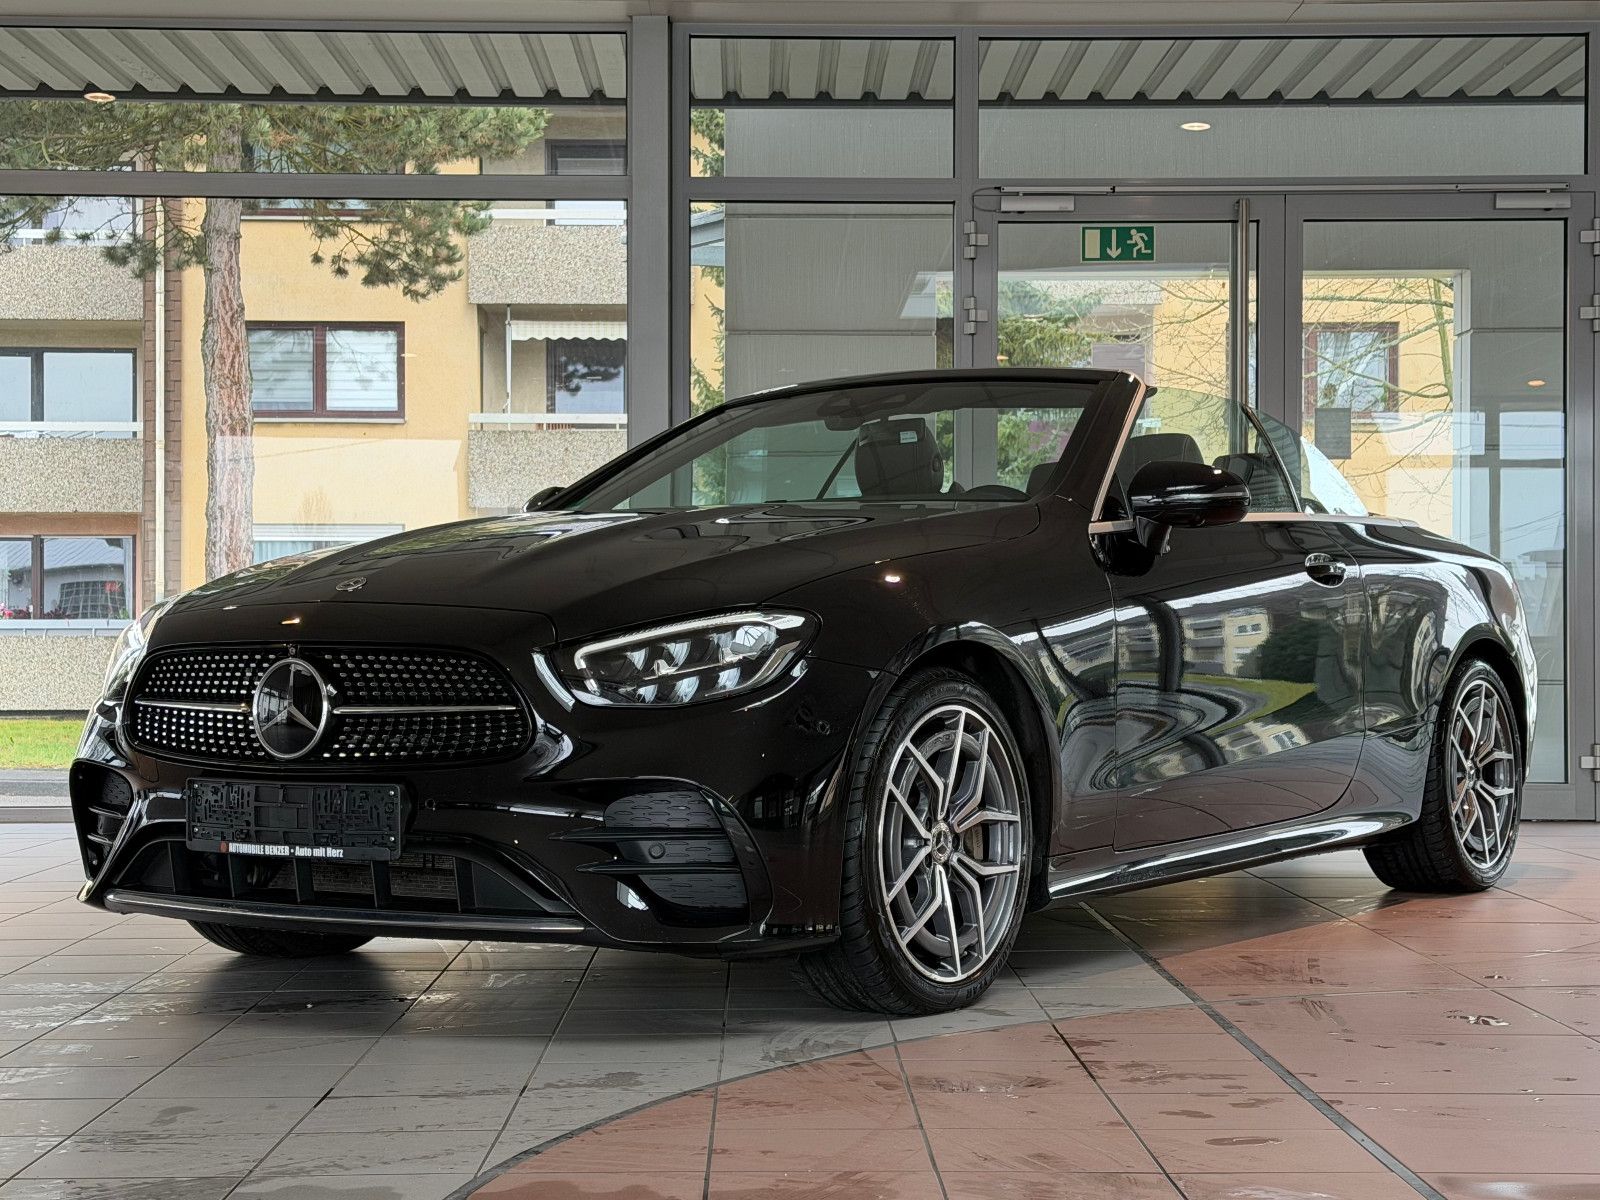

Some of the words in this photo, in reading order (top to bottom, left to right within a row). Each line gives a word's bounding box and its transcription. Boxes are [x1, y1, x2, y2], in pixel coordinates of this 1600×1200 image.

[228, 842, 264, 855] AUTOMOBILE
[265, 845, 290, 856] BENZER
[295, 846, 312, 857] Auto
[313, 847, 325, 858] mit
[327, 847, 344, 858] Herz
